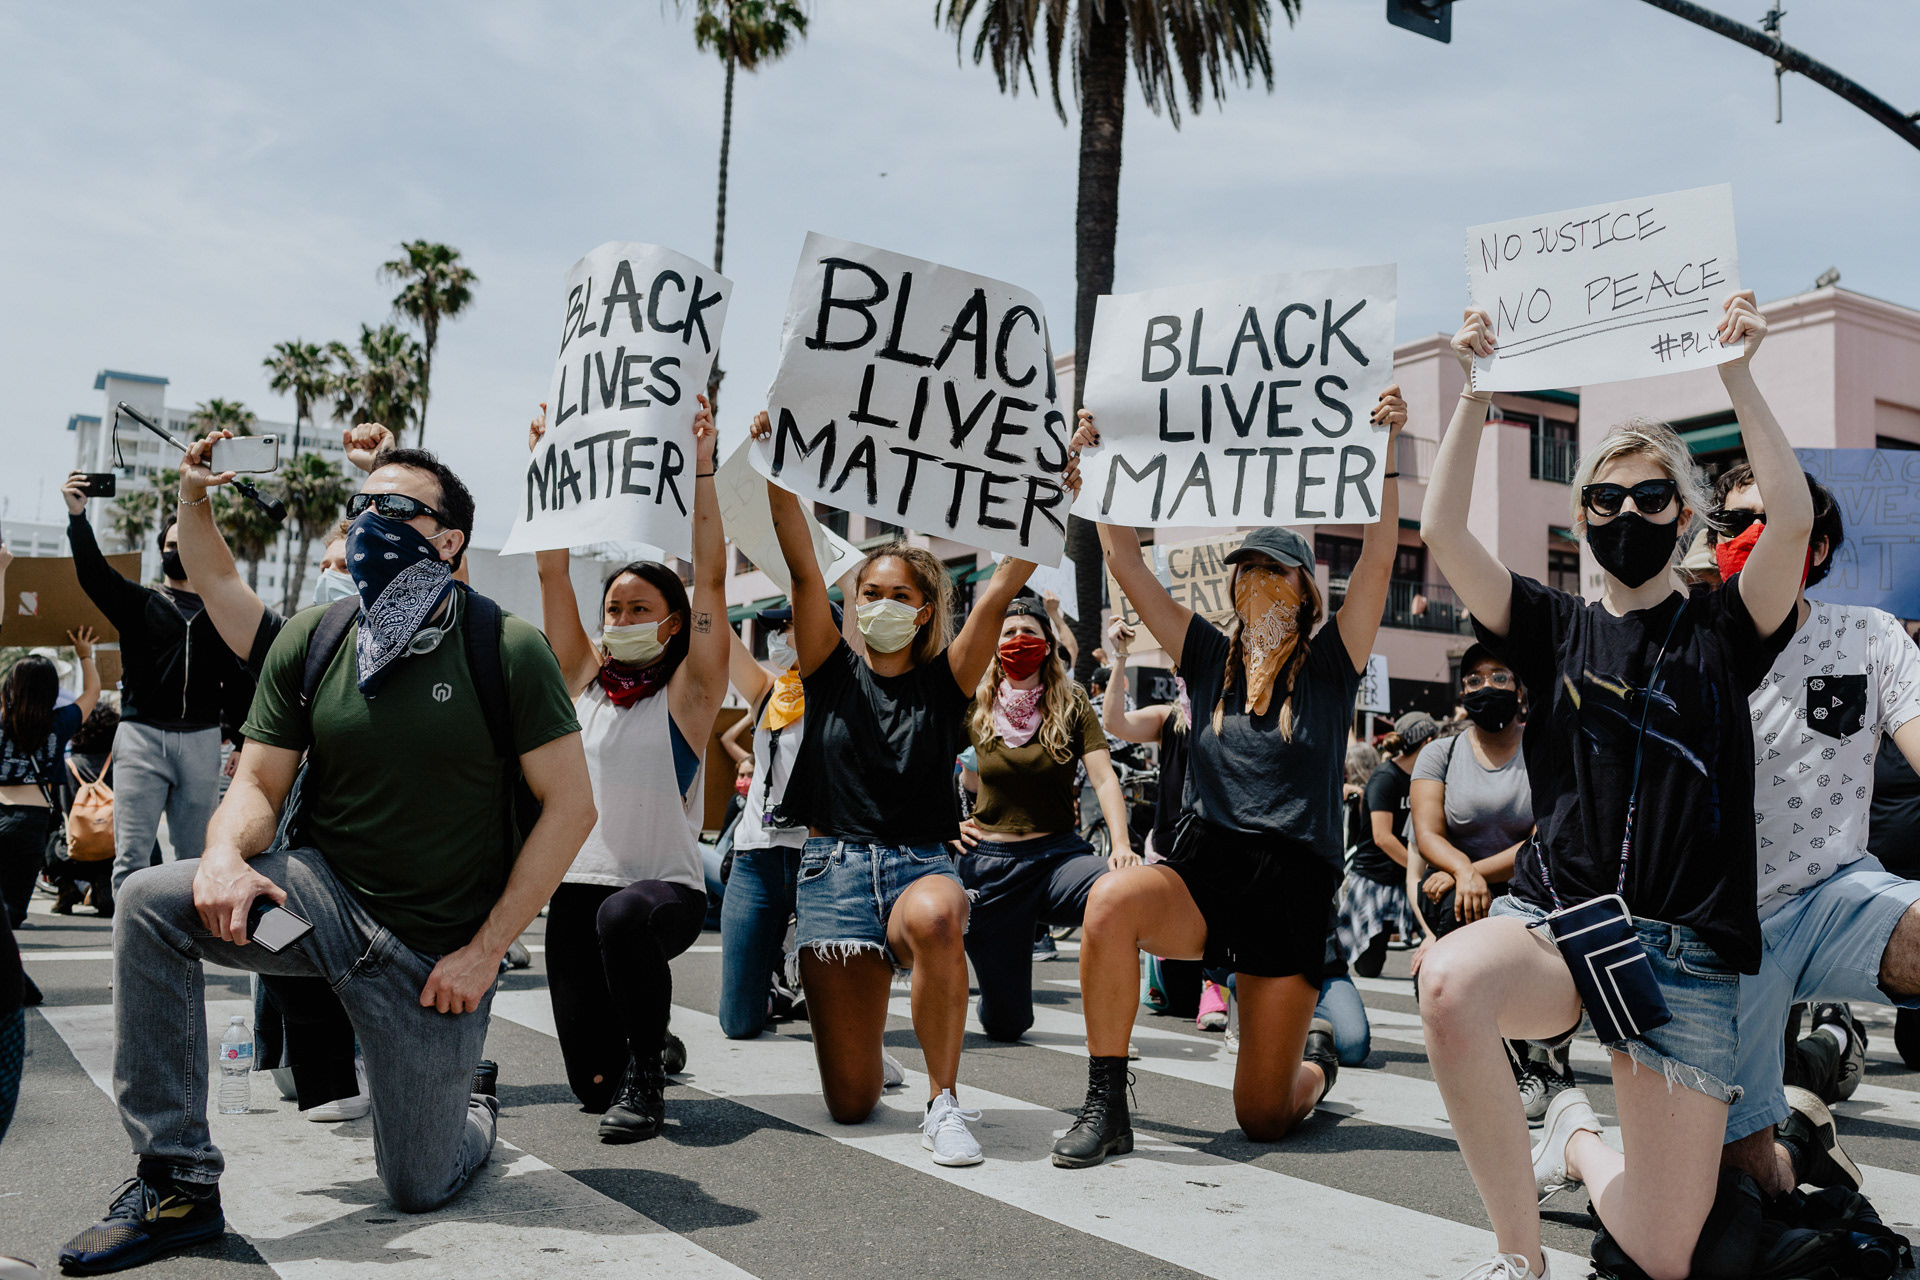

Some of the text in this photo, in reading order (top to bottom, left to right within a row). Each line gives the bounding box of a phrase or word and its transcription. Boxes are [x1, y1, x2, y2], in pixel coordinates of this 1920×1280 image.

[1480, 208, 1666, 273] NO JUSTICE
[558, 259, 723, 359] BLACK
[804, 256, 1057, 406] BLAC
[1497, 258, 1726, 337] NO PEACE
[1141, 298, 1370, 382] BLACK
[555, 346, 681, 427] LIVES
[848, 364, 1068, 474] LIVES
[1159, 374, 1353, 444] LIVES
[526, 429, 687, 522] MATTER
[771, 408, 1066, 547] MATTER
[1101, 445, 1379, 522] MATTER
